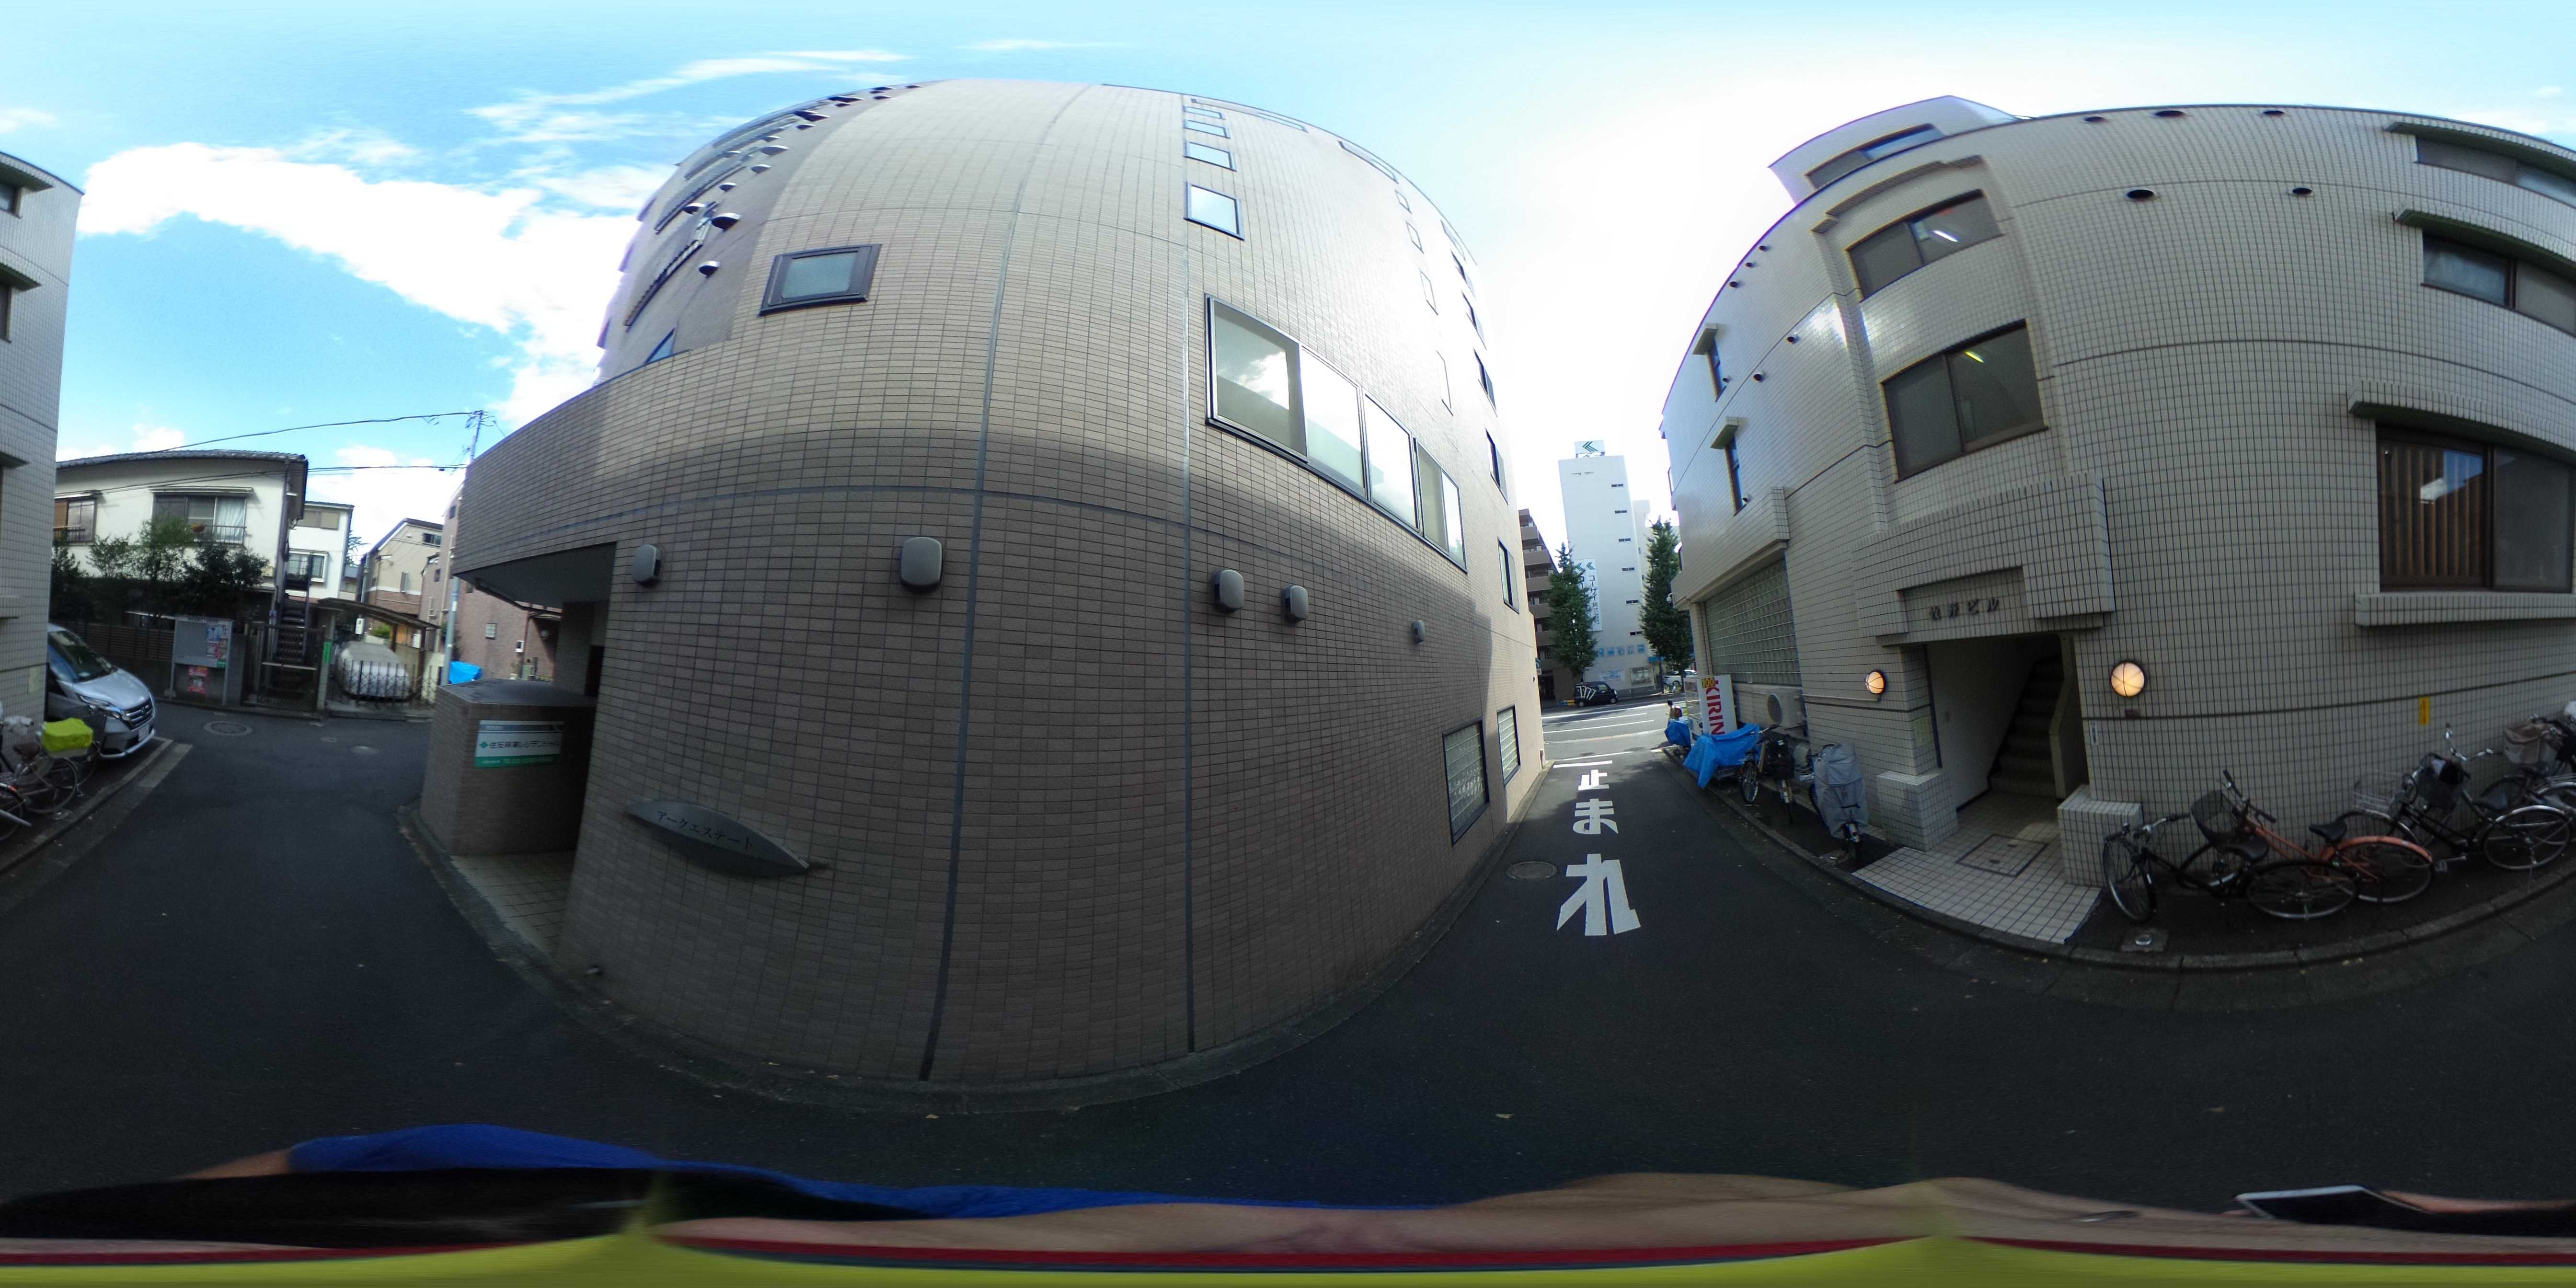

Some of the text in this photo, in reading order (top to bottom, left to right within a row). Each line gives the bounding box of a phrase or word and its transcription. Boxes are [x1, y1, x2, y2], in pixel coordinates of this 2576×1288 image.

[1706, 680, 1725, 735] KIRIN
[658, 810, 753, 850] アークエステート
[1556, 769, 1641, 936] 止まれ
